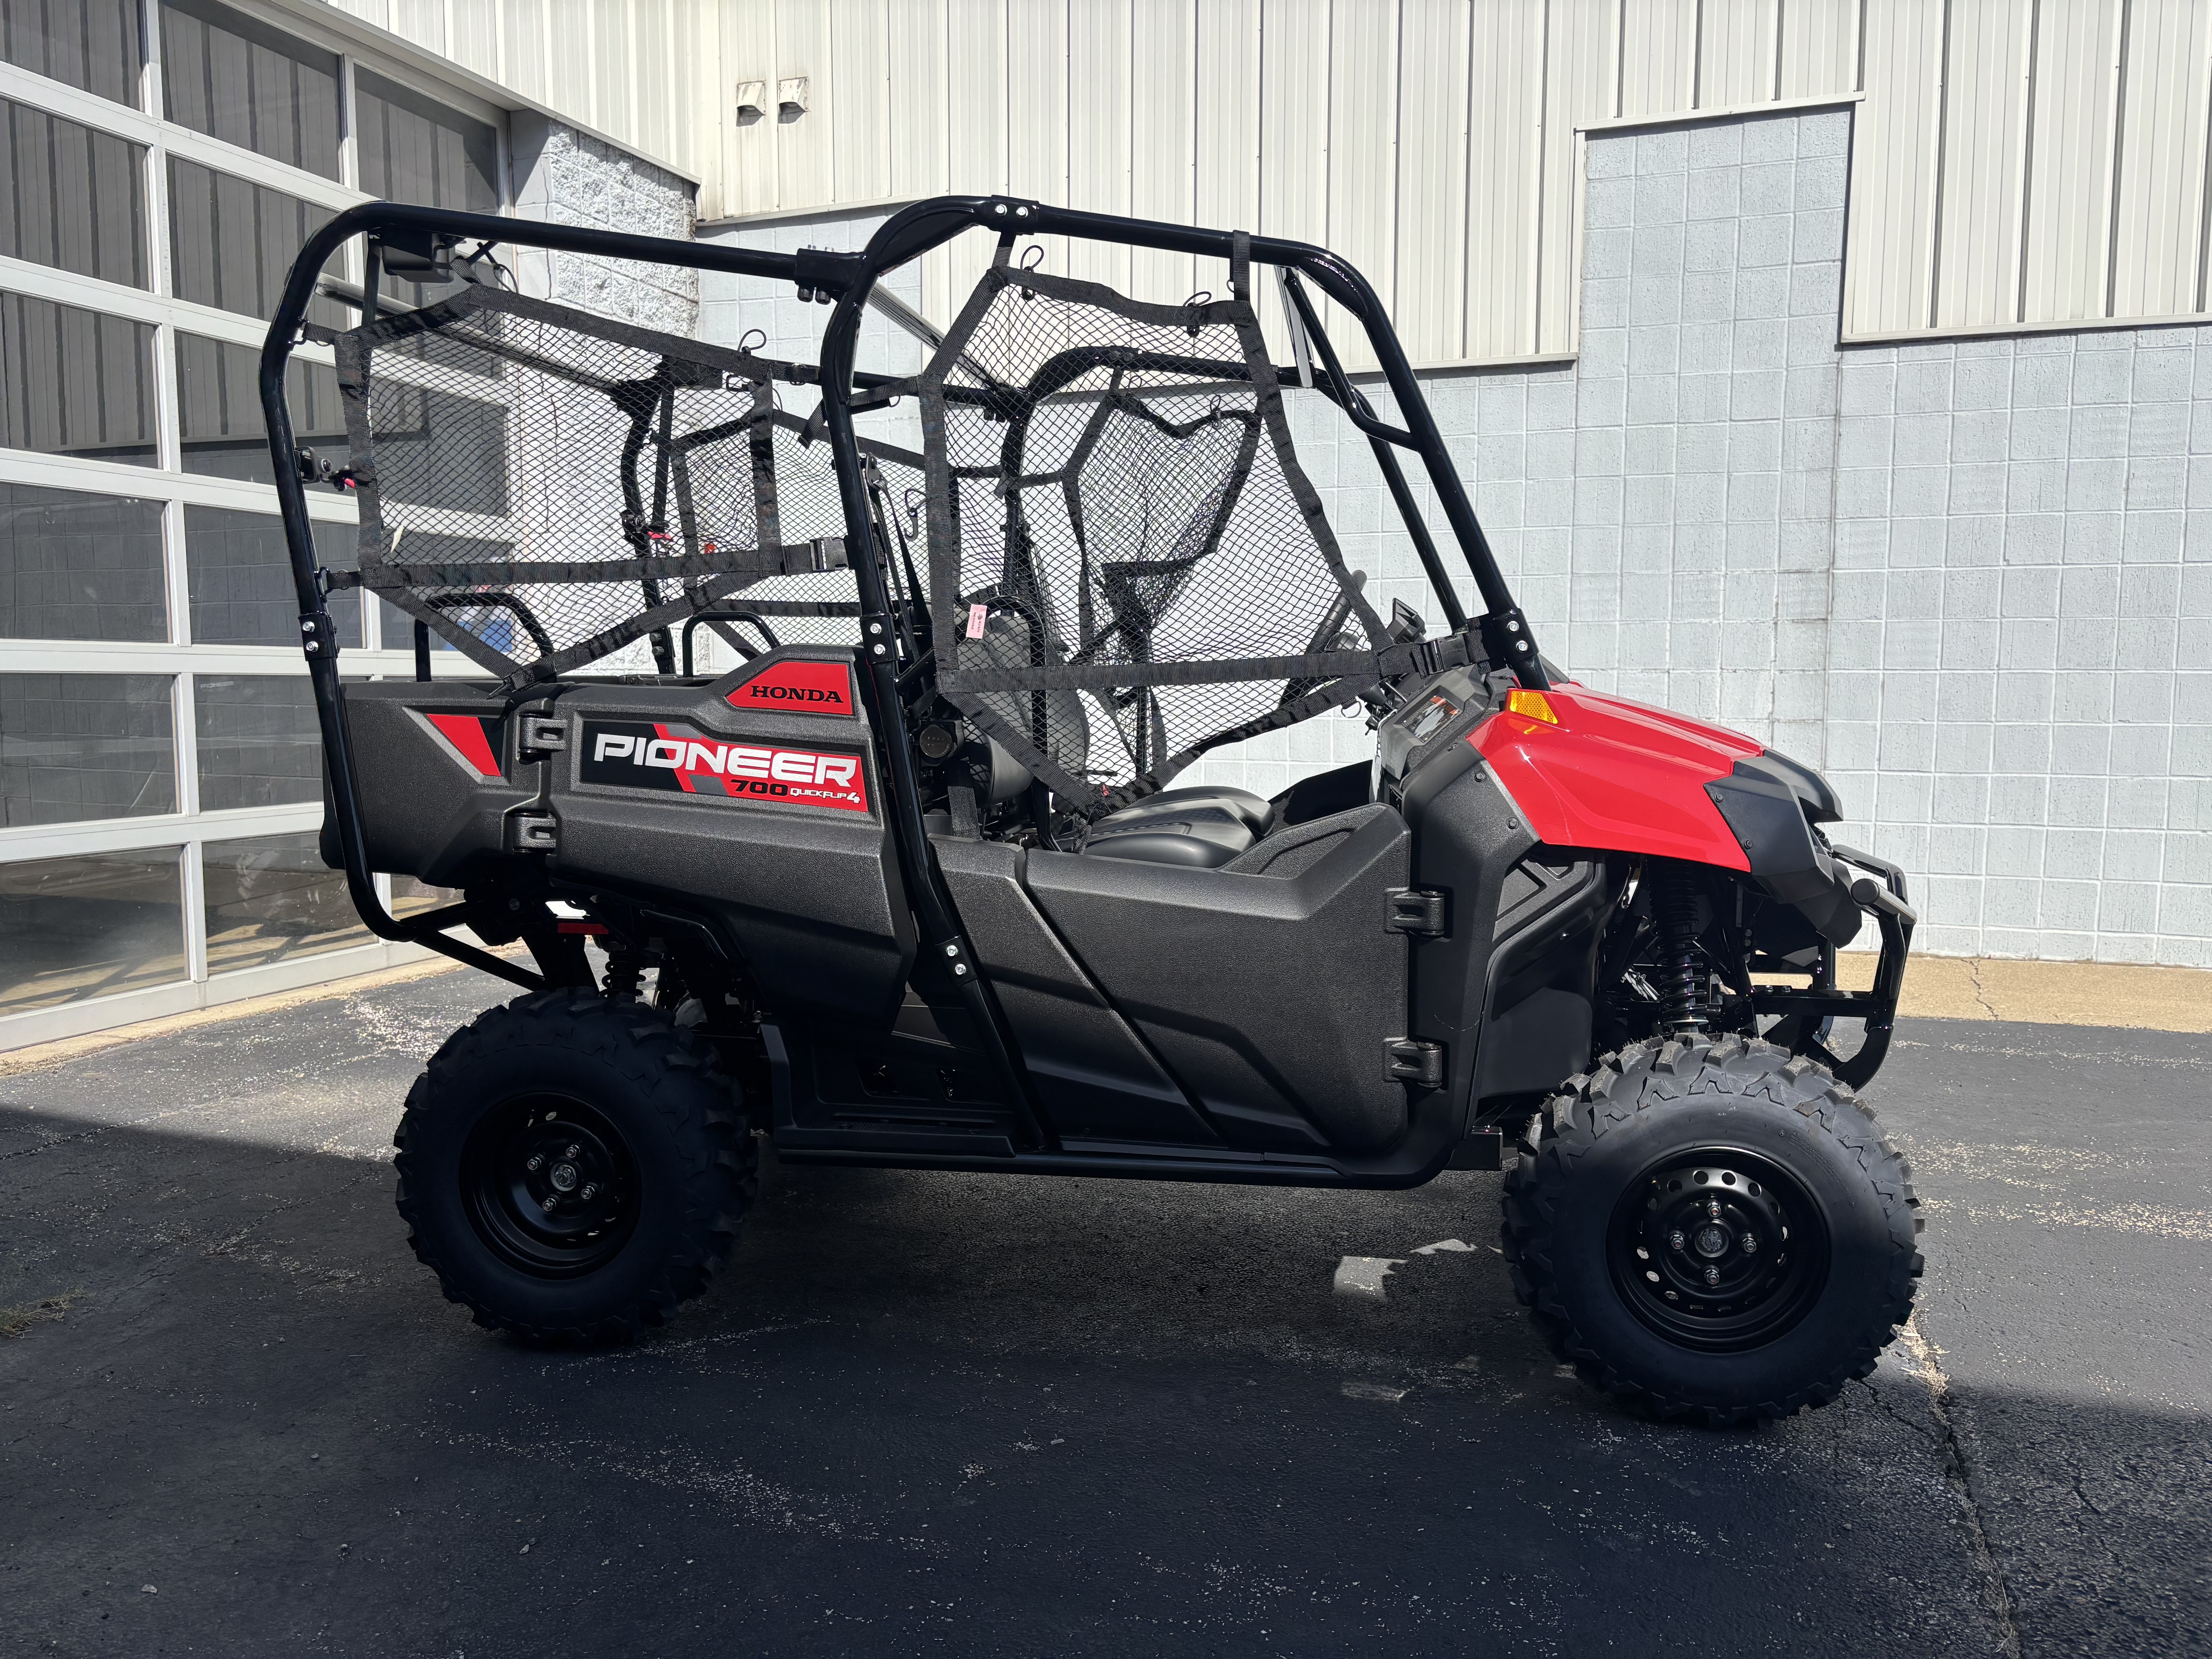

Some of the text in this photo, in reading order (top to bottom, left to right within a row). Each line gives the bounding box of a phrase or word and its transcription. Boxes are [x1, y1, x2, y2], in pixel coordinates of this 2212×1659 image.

[750, 685, 844, 703] HONDA
[594, 733, 857, 787] PIONEER
[730, 779, 788, 796] 700
